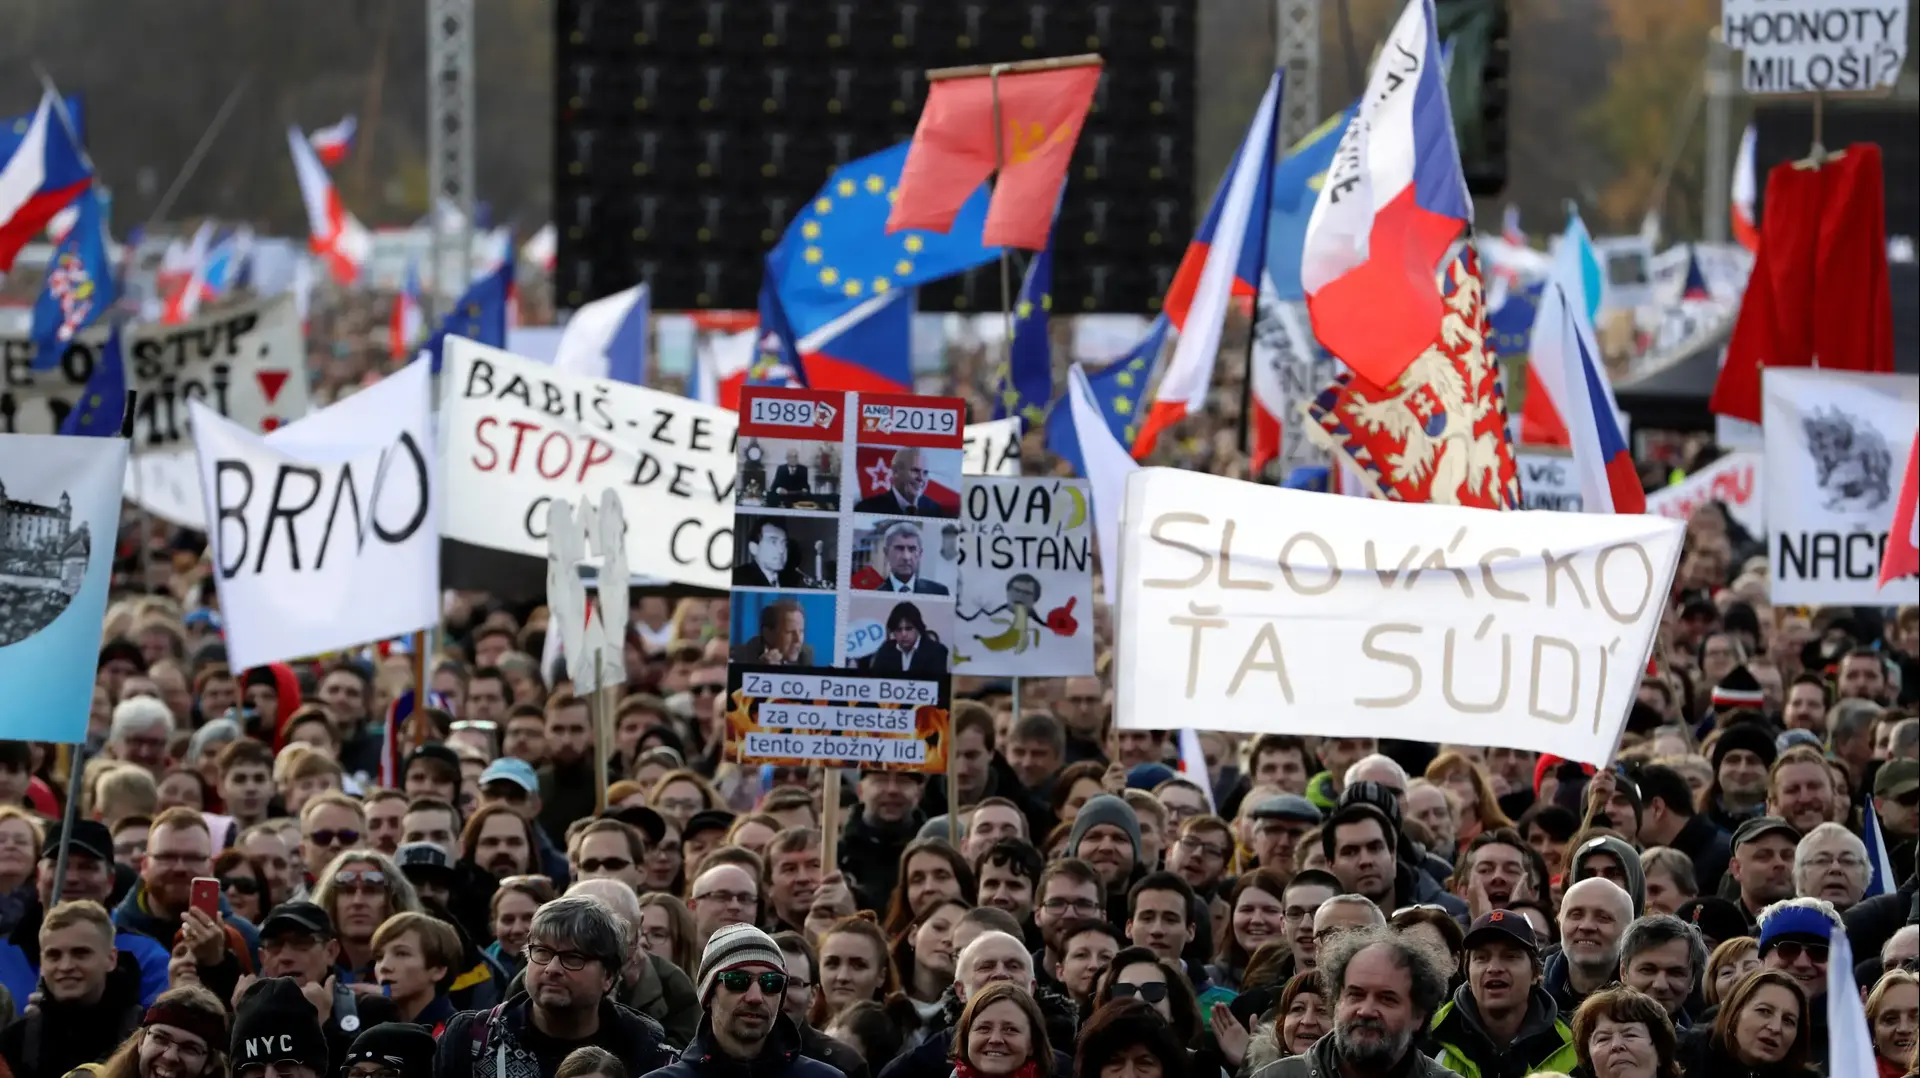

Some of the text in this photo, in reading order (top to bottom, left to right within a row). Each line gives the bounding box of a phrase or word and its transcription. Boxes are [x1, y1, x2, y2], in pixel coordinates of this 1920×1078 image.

[1727, 8, 1898, 45] HODNOTY
[62, 313, 270, 385] OSTUP.
[464, 359, 738, 453] BABIŠ-ZE
[754, 402, 812, 424] 1989
[895, 409, 954, 432] 2019
[472, 416, 613, 483] STOP
[216, 431, 429, 579] BRNO
[1143, 511, 1654, 624] SLOVÁCKO
[1169, 601, 1621, 735] ŤA SÚDÍ
[746, 676, 936, 705] Za co, Pane Bože,
[766, 710, 908, 730] za co, trestáš
[750, 735, 924, 761] tento zbožný lid.
[246, 1034, 293, 1058] NYC
